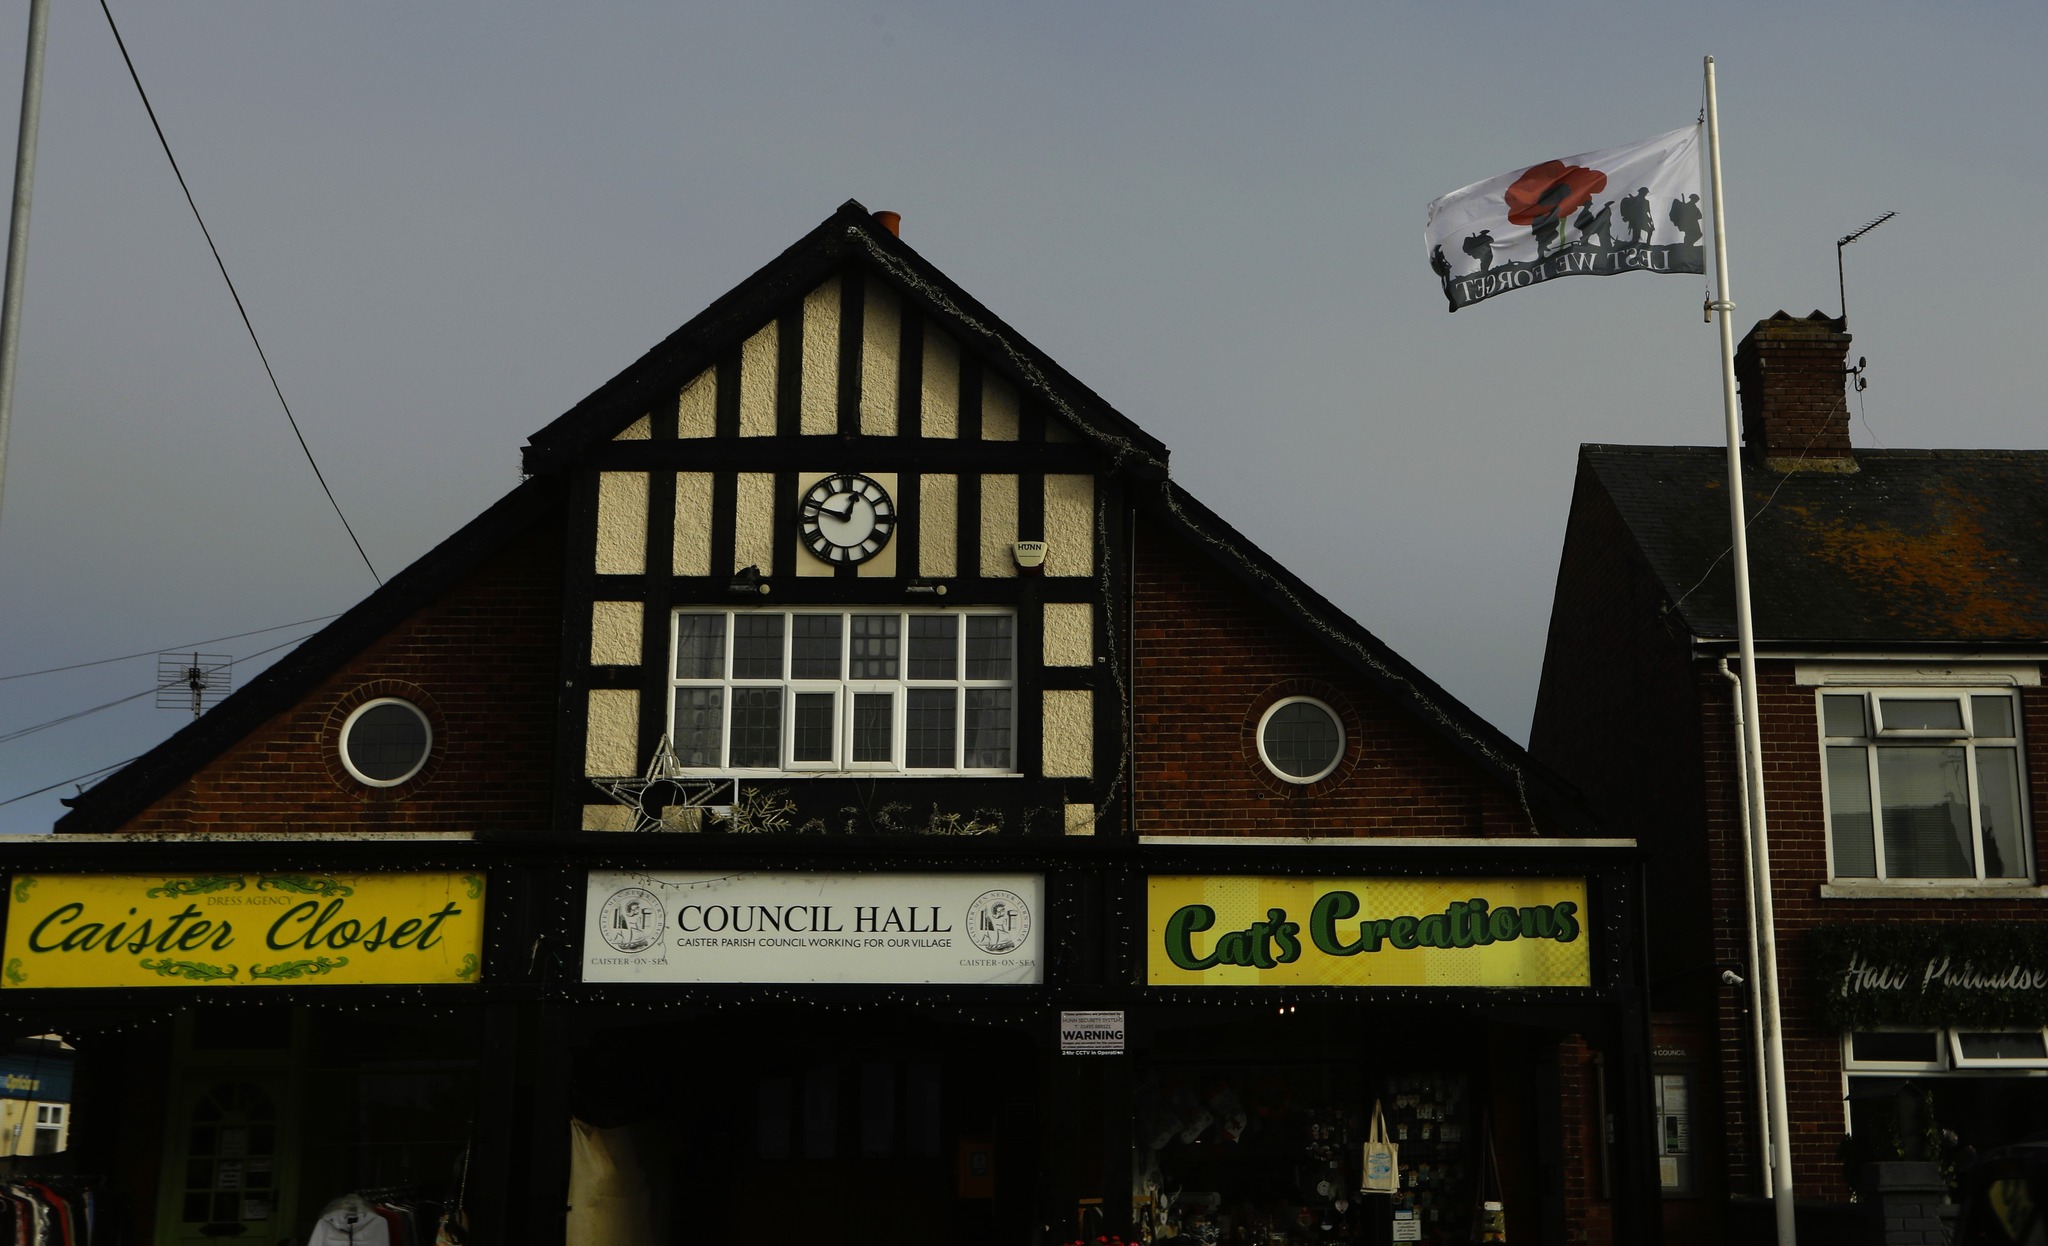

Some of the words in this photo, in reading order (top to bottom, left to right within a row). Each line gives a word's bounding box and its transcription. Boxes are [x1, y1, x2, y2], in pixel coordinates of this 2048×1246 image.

[1018, 543, 1042, 551] HUNN
[207, 896, 243, 906] DRESS
[246, 896, 293, 906] AGENCY
[677, 904, 844, 933] COUNCIL
[854, 905, 952, 933] HALL
[28, 902, 235, 955] Caister
[266, 898, 462, 952] Closet
[1164, 904, 1302, 971] Cat's
[1309, 890, 1581, 957] Creations
[677, 938, 718, 948] CAISTER
[721, 938, 756, 948] PARISH
[758, 938, 807, 948] COUNCIL
[808, 938, 861, 948] WORKING
[864, 938, 884, 948] FOR
[887, 938, 910, 948] OUR
[911, 938, 952, 948] VILLAGE
[1062, 1030, 1123, 1040] WARNING
